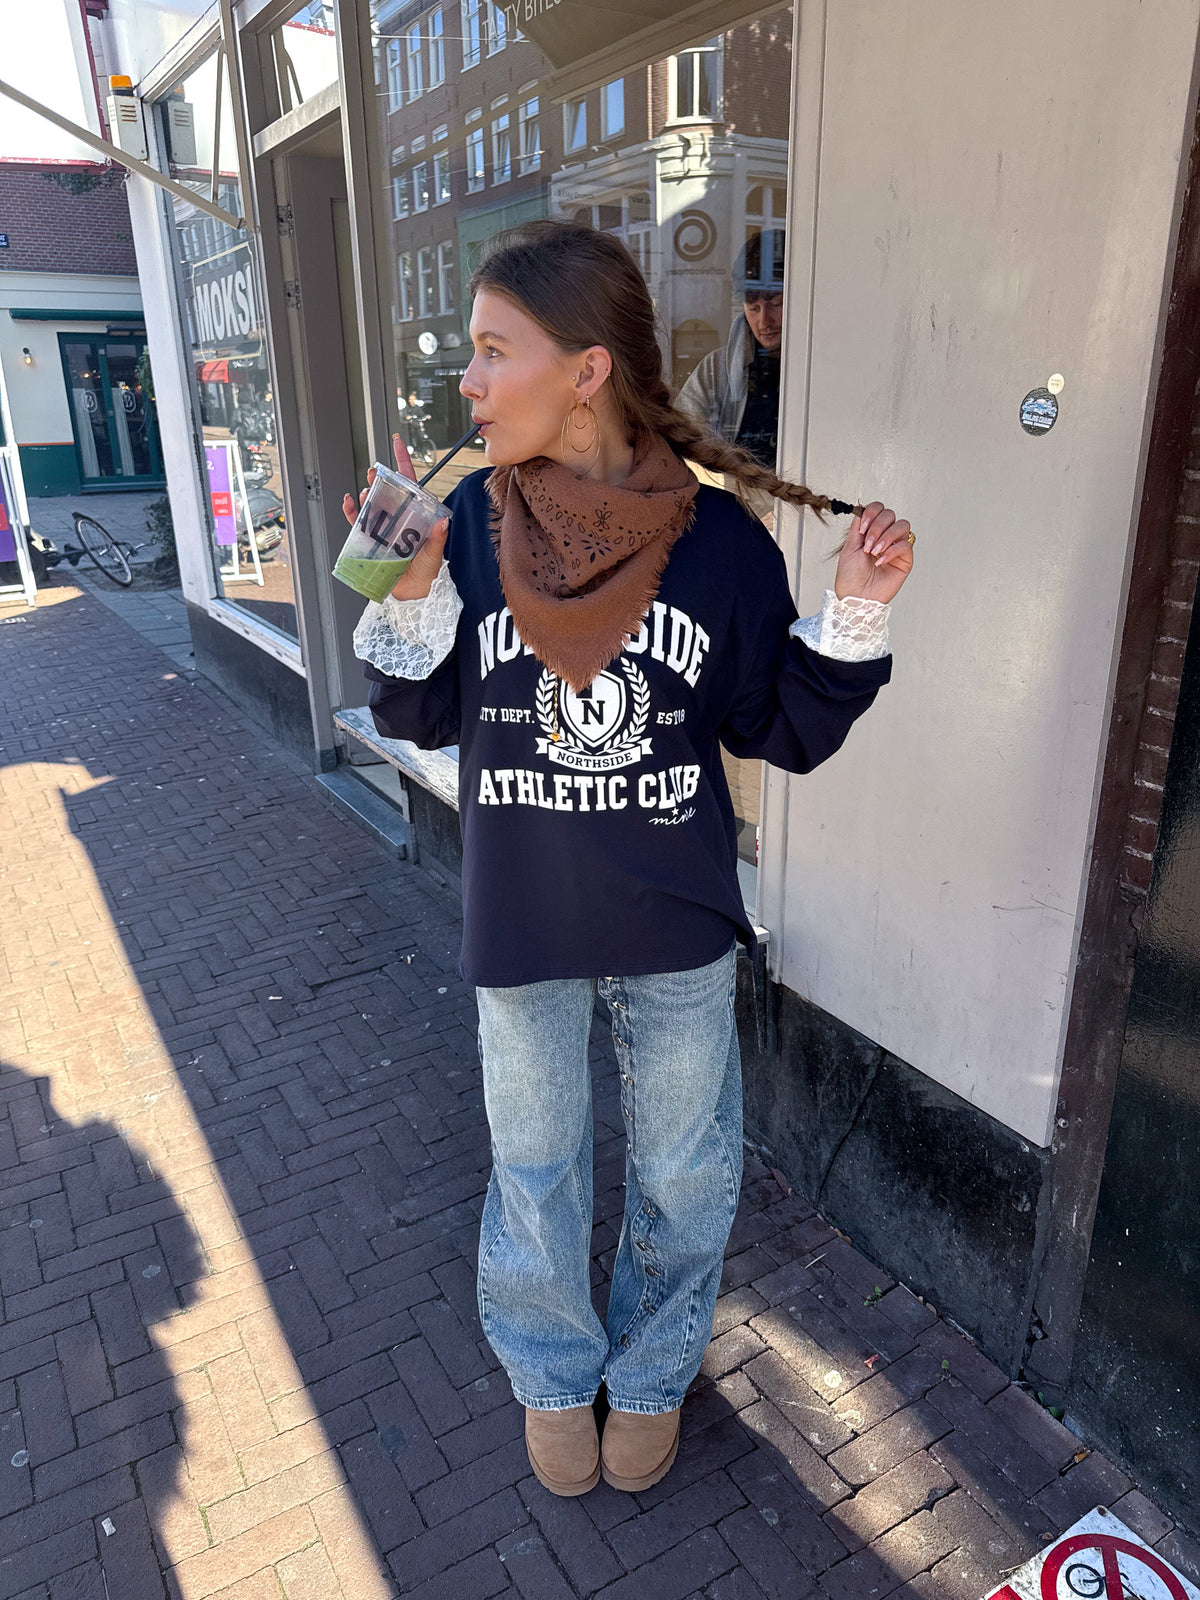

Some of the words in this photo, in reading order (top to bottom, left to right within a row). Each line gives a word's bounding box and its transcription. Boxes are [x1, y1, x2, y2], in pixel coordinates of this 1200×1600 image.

[482, 0, 521, 45] TASTY
[196, 265, 256, 341] MOKSI
[478, 600, 711, 689] NOSIDE
[500, 708, 535, 724] DEPT.
[581, 700, 606, 726] N
[556, 751, 633, 769] NORTHSIDE
[478, 768, 628, 812] ATHLETIC
[638, 764, 701, 810] CLUB
